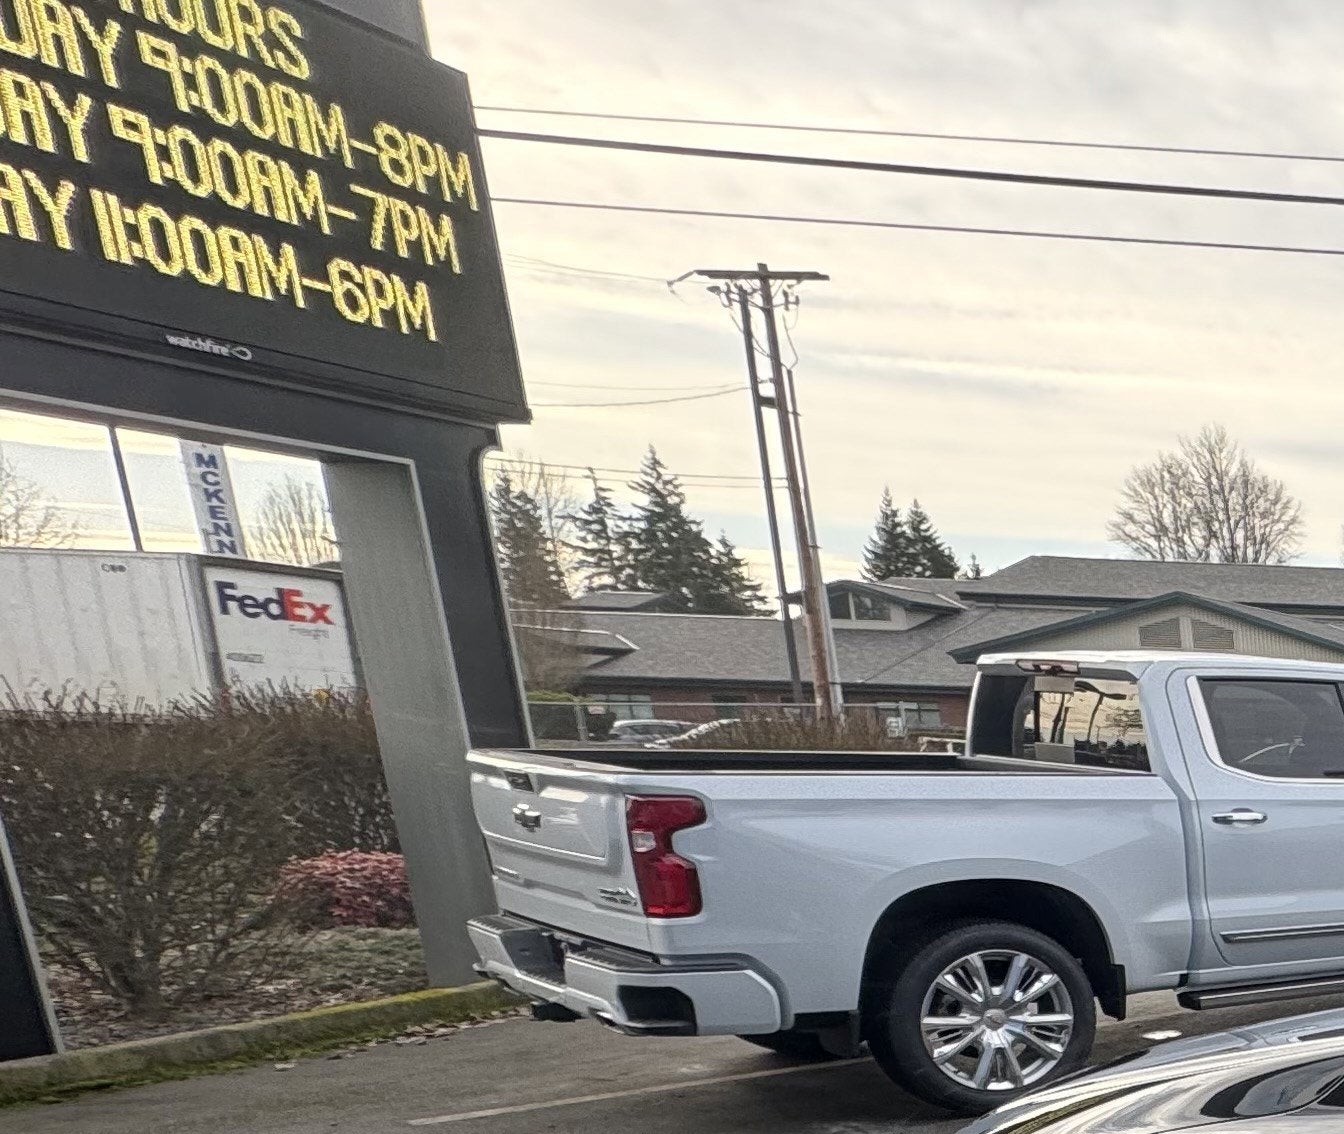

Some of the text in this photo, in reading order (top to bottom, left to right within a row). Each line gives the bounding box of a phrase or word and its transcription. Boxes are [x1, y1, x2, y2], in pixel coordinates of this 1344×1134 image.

[117, 0, 311, 81] URS
[0, 67, 462, 275] AY 9:00AM-7PM
[135, 29, 479, 211] 9:00AM-8PM
[88, 186, 439, 342] 11:00AM-6PM
[214, 580, 335, 625] FedEx
